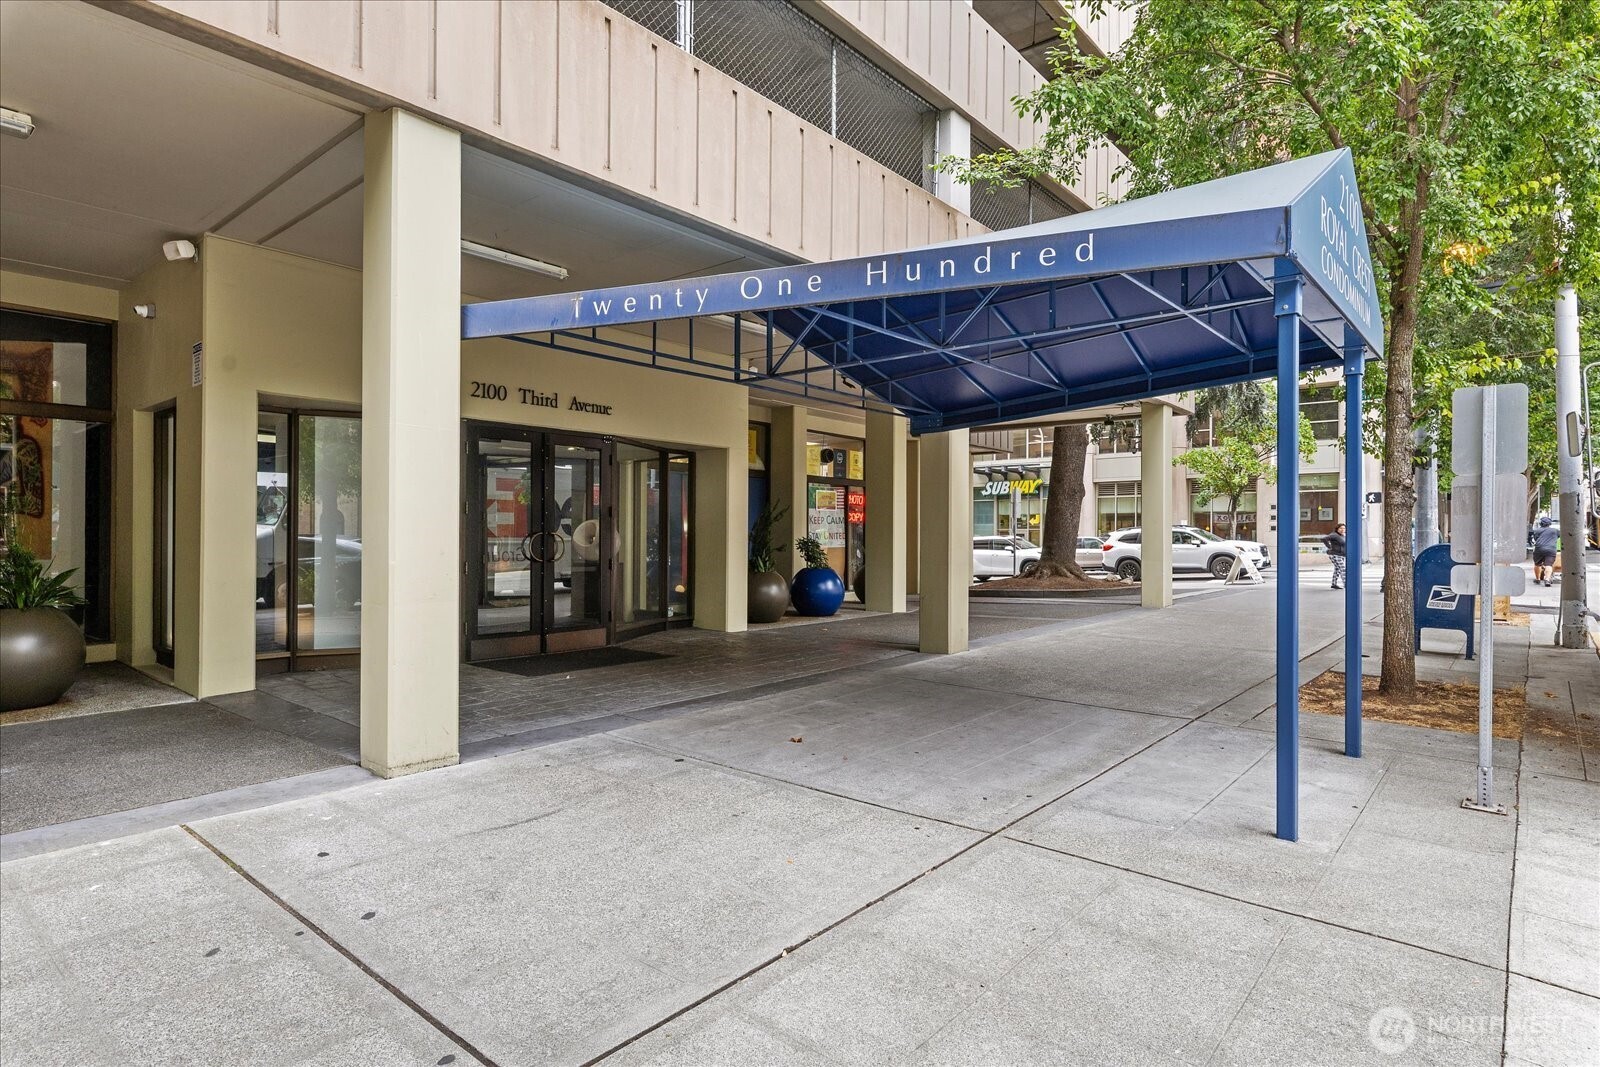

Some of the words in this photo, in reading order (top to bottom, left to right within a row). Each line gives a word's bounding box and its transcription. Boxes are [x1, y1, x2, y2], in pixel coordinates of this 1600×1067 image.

[1339, 175, 1360, 236] 2100
[571, 287, 708, 318] Twenty
[740, 275, 822, 299] One
[867, 233, 1094, 285] Hundred
[1321, 195, 1350, 266] ROYAL
[1352, 246, 1372, 297] CREST
[1321, 246, 1371, 328] CONDOMINIUM
[471, 382, 507, 401] 2100
[519, 387, 558, 408] Third
[568, 396, 612, 415] Avenue
[982, 479, 1042, 496] SUBWAY
